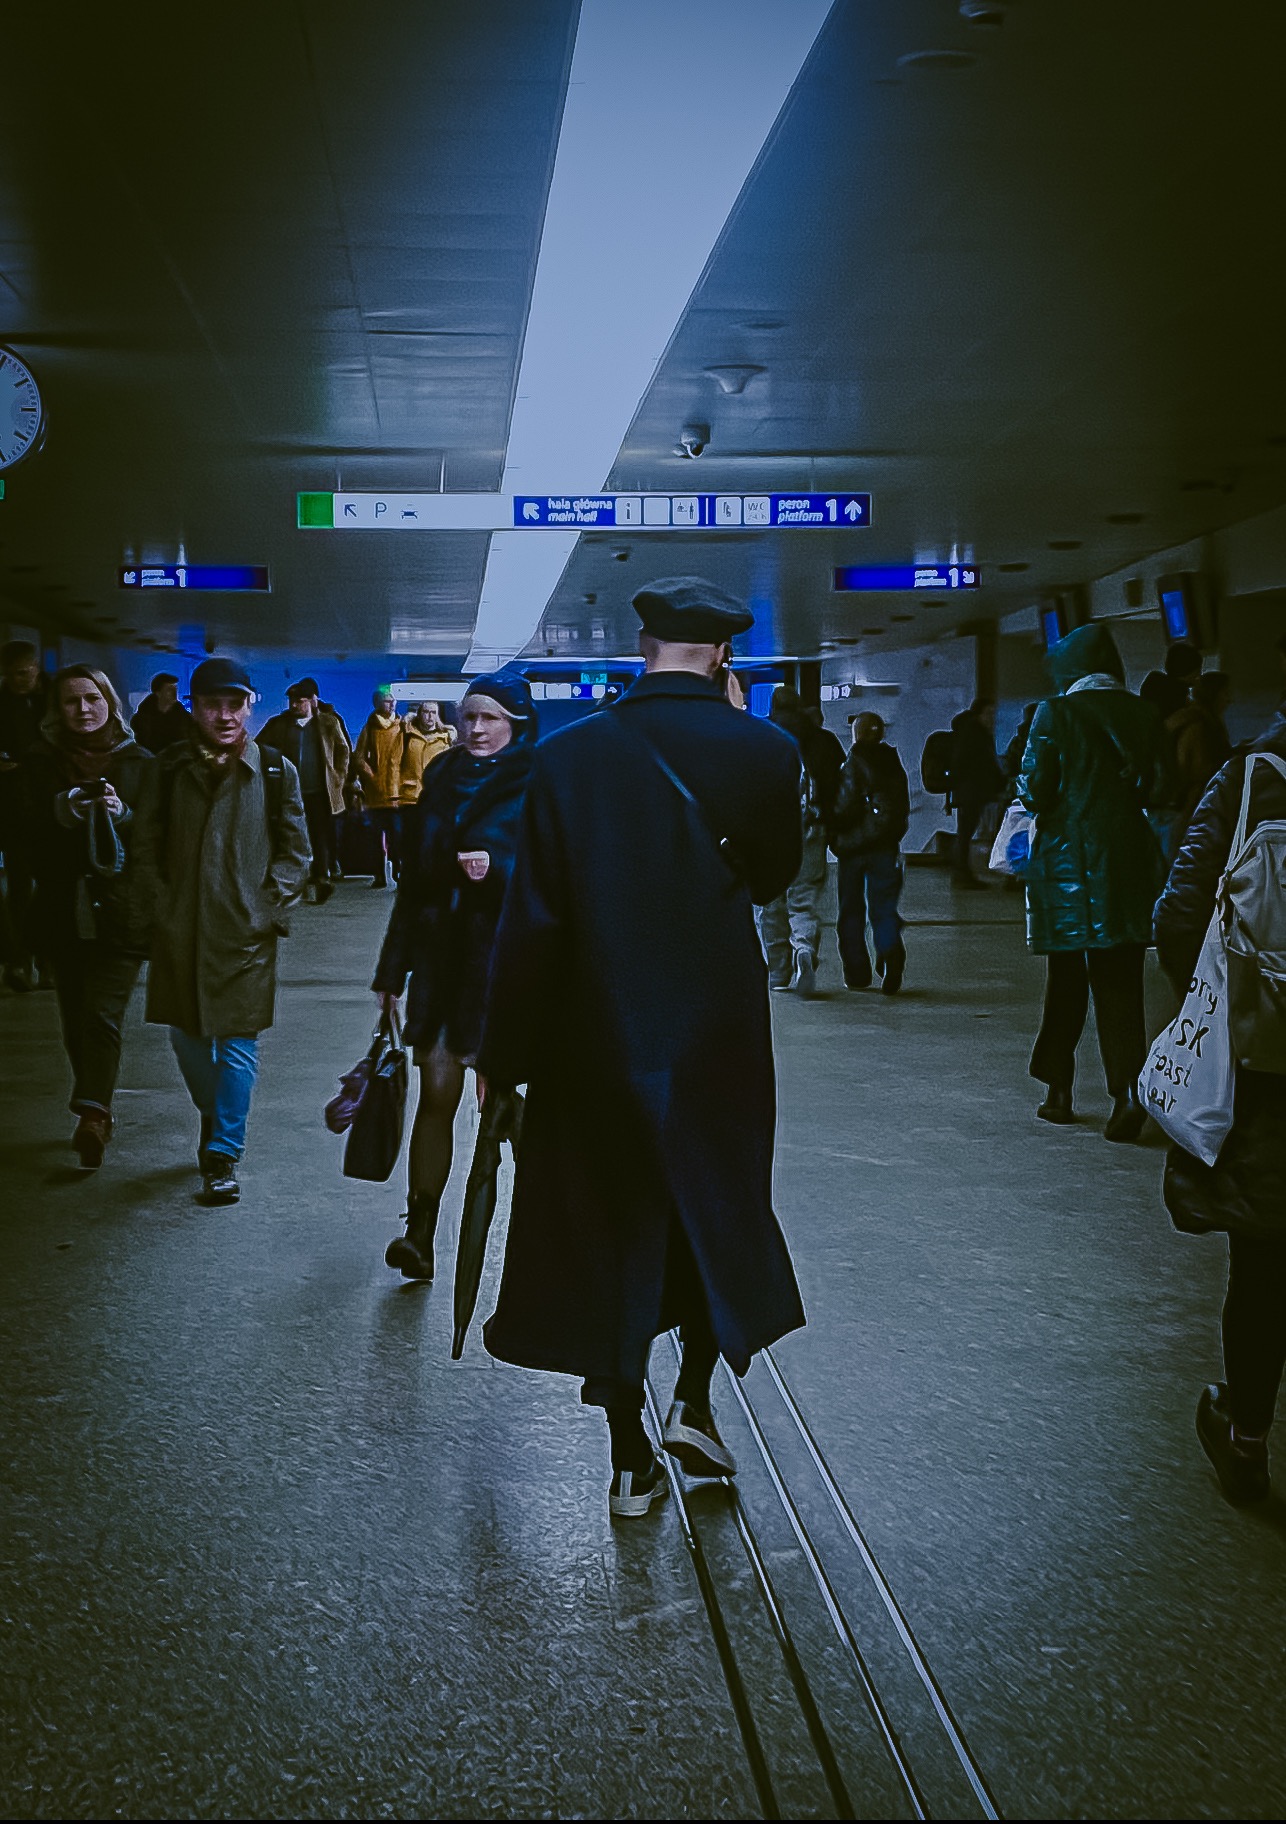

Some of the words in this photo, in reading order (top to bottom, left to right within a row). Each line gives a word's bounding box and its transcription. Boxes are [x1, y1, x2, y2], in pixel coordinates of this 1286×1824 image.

[374, 501, 388, 519] P
[547, 498, 571, 510] hala
[747, 502, 765, 511] WC
[778, 499, 810, 511] peron
[826, 499, 838, 522] 1
[547, 511, 576, 522] main
[777, 510, 824, 524] platform
[175, 568, 187, 588] 1
[948, 567, 959, 588] 1
